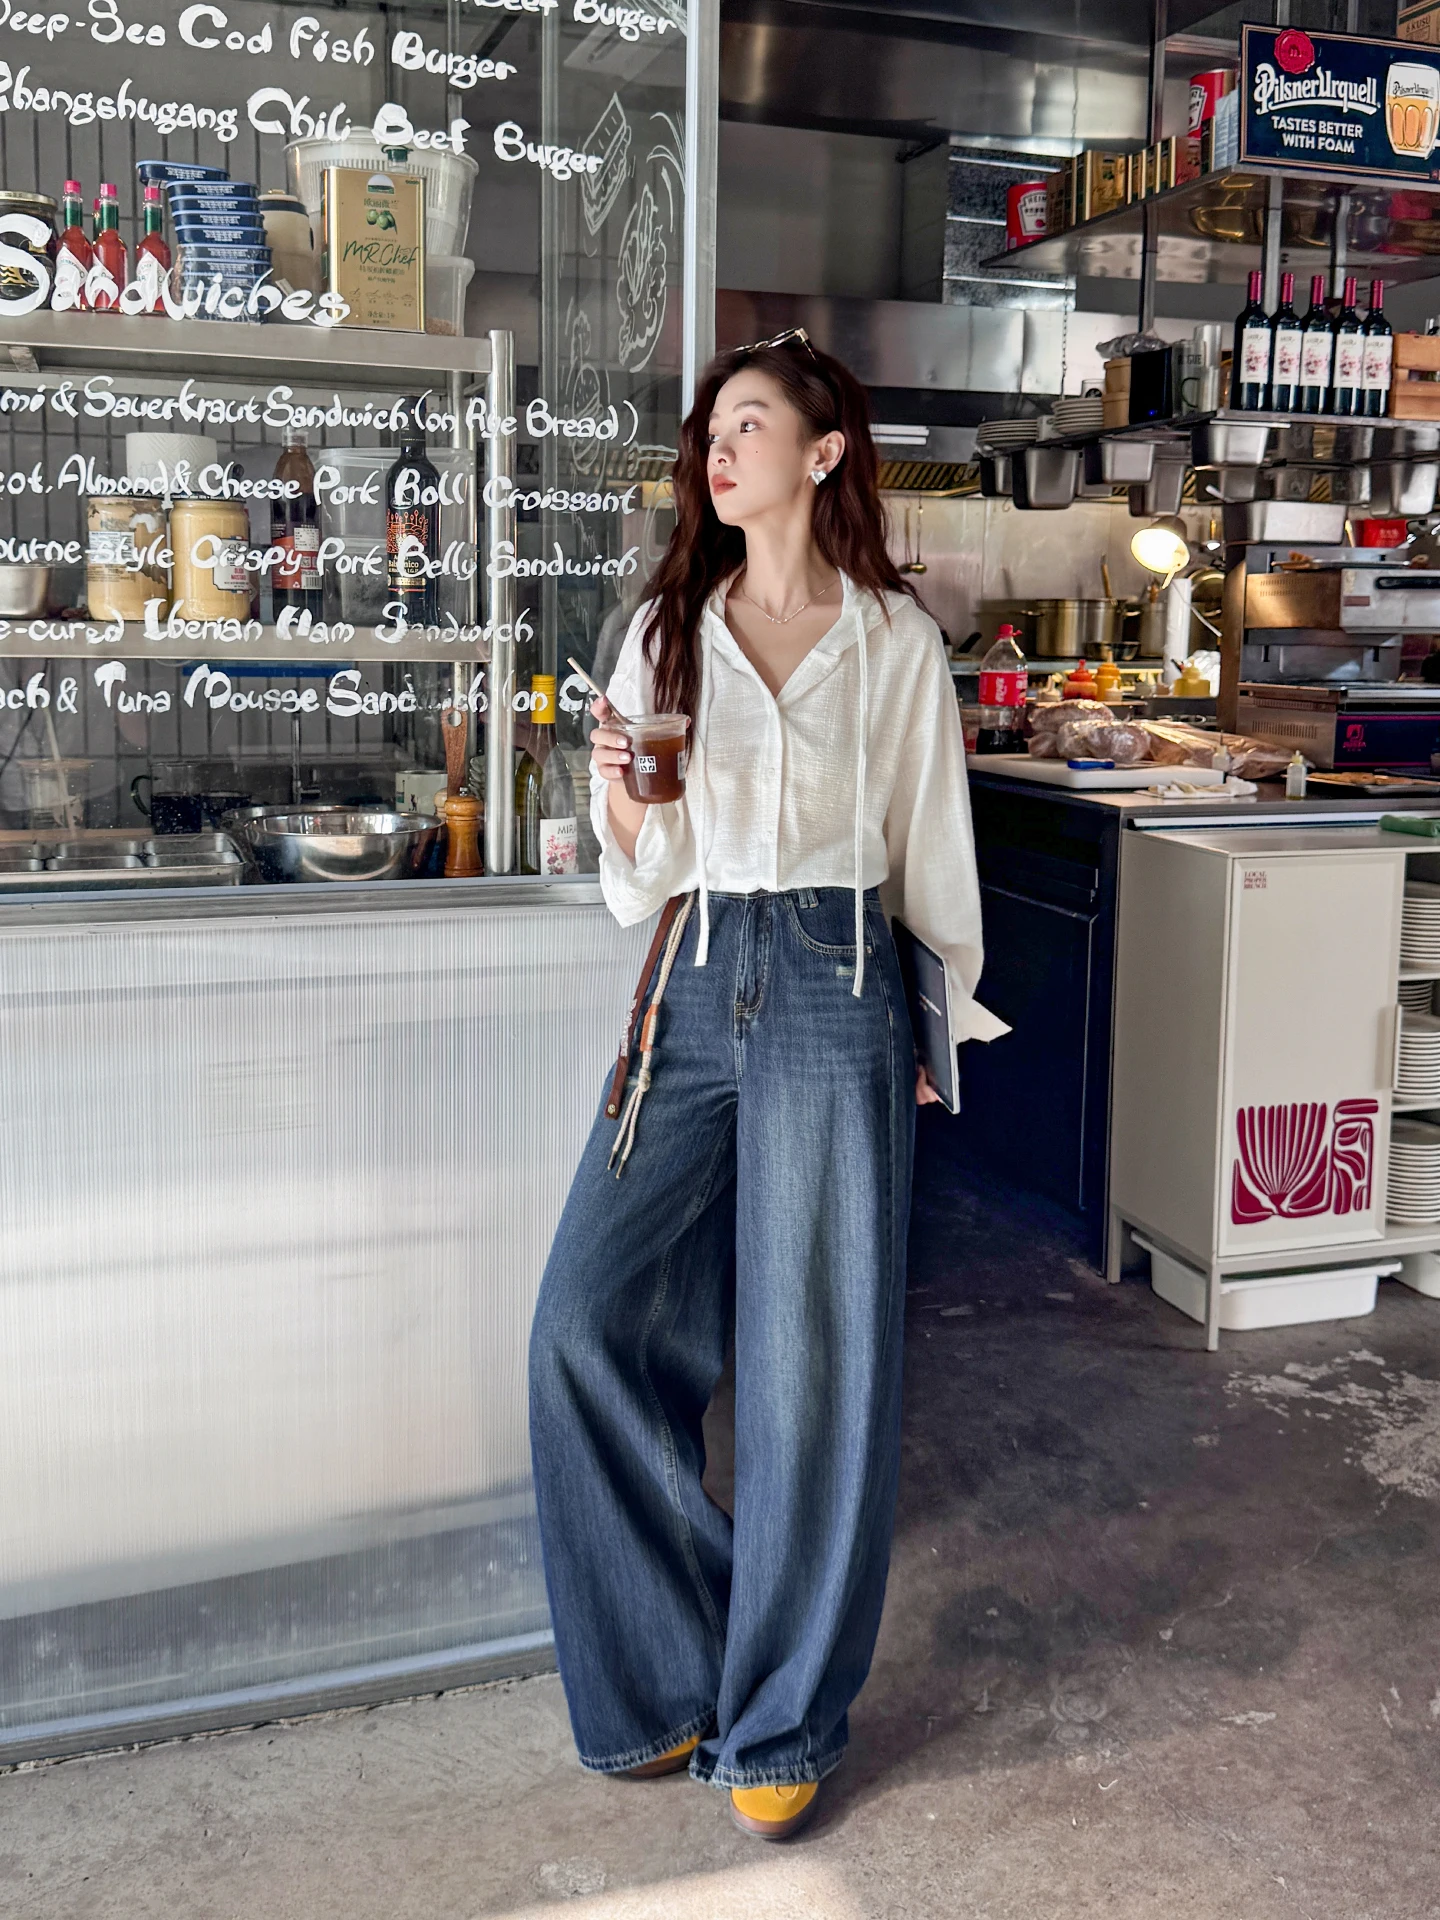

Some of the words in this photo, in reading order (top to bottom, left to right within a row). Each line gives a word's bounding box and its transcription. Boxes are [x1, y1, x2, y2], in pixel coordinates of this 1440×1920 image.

[179, 3, 273, 54] Cod
[290, 16, 375, 66] Fish
[391, 30, 517, 89] Burger
[473, 0, 559, 16] eef
[573, 0, 677, 41] Burger
[247, 87, 352, 142] Chili
[371, 103, 471, 155] Beef
[494, 121, 604, 181] Burger
[1271, 116, 1317, 134] TASTES
[1318, 120, 1364, 139] BETTER
[1282, 133, 1316, 150] WITH
[1318, 137, 1356, 155] FOAM
[0, 213, 351, 328] Sandwiches
[263, 385, 408, 432] Sandwich
[466, 397, 518, 439] Rye
[198, 462, 303, 499] Cheese
[313, 465, 380, 505] Pork
[483, 475, 638, 515] Croissant
[190, 534, 304, 576] Crispy
[317, 537, 382, 577] Pork
[397, 535, 477, 581] Belly
[486, 540, 640, 579] Sandwich
[143, 597, 264, 642] Iberian
[276, 605, 356, 645] Ham
[56, 677, 79, 714] &
[94, 661, 172, 713] Tuna
[184, 663, 320, 714] Mousse
[326, 669, 489, 717] Sandich
